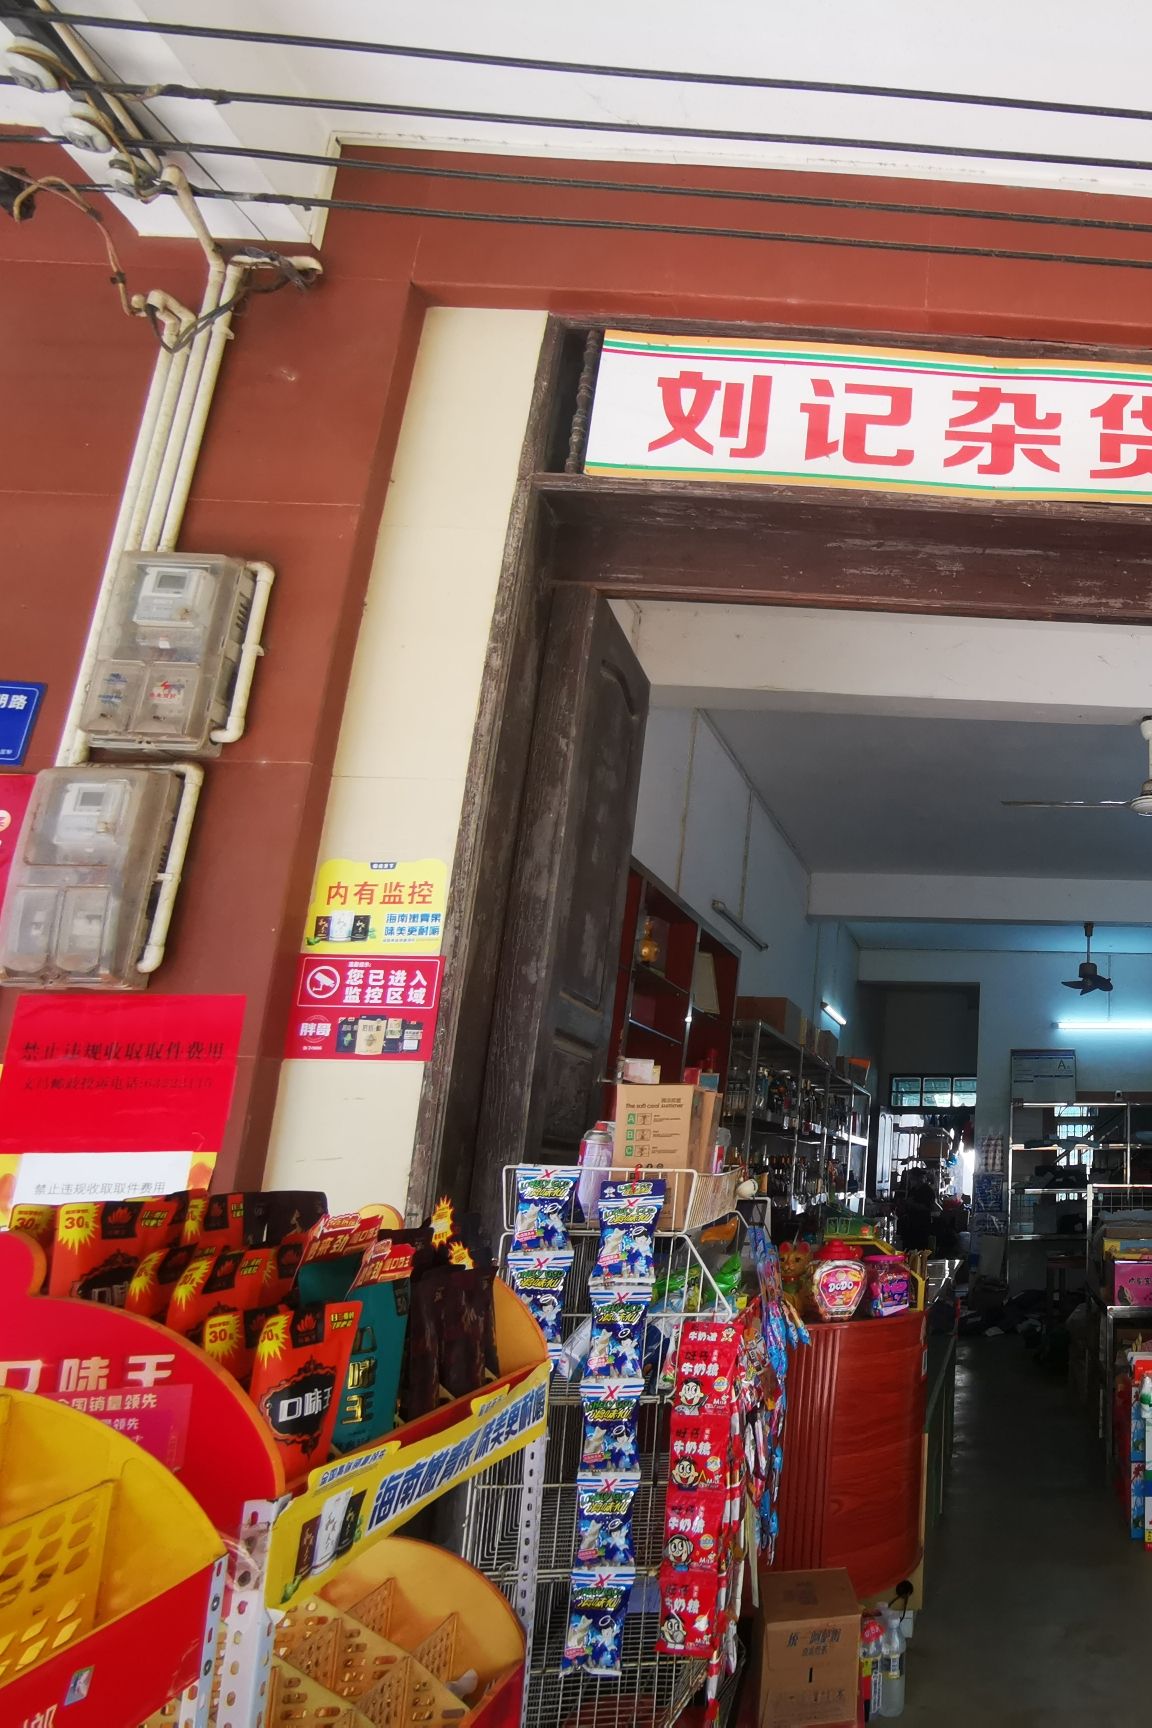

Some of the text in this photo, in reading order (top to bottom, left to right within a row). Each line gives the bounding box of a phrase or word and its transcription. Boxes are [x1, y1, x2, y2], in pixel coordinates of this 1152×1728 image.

[326, 881, 434, 905] 内有监控
[345, 969, 428, 986] 您已进入
[343, 986, 426, 1005] 监控区域
[299, 1022, 331, 1037] 胖哥
[21, 1041, 225, 1061] 禁止违规收取取件费用
[34, 1181, 166, 1196] 禁止违规收取取件费用
[681, 1362, 719, 1377] 牛奶糖
[278, 1386, 333, 1423] 口味王
[673, 1440, 712, 1456] 牛奶糖
